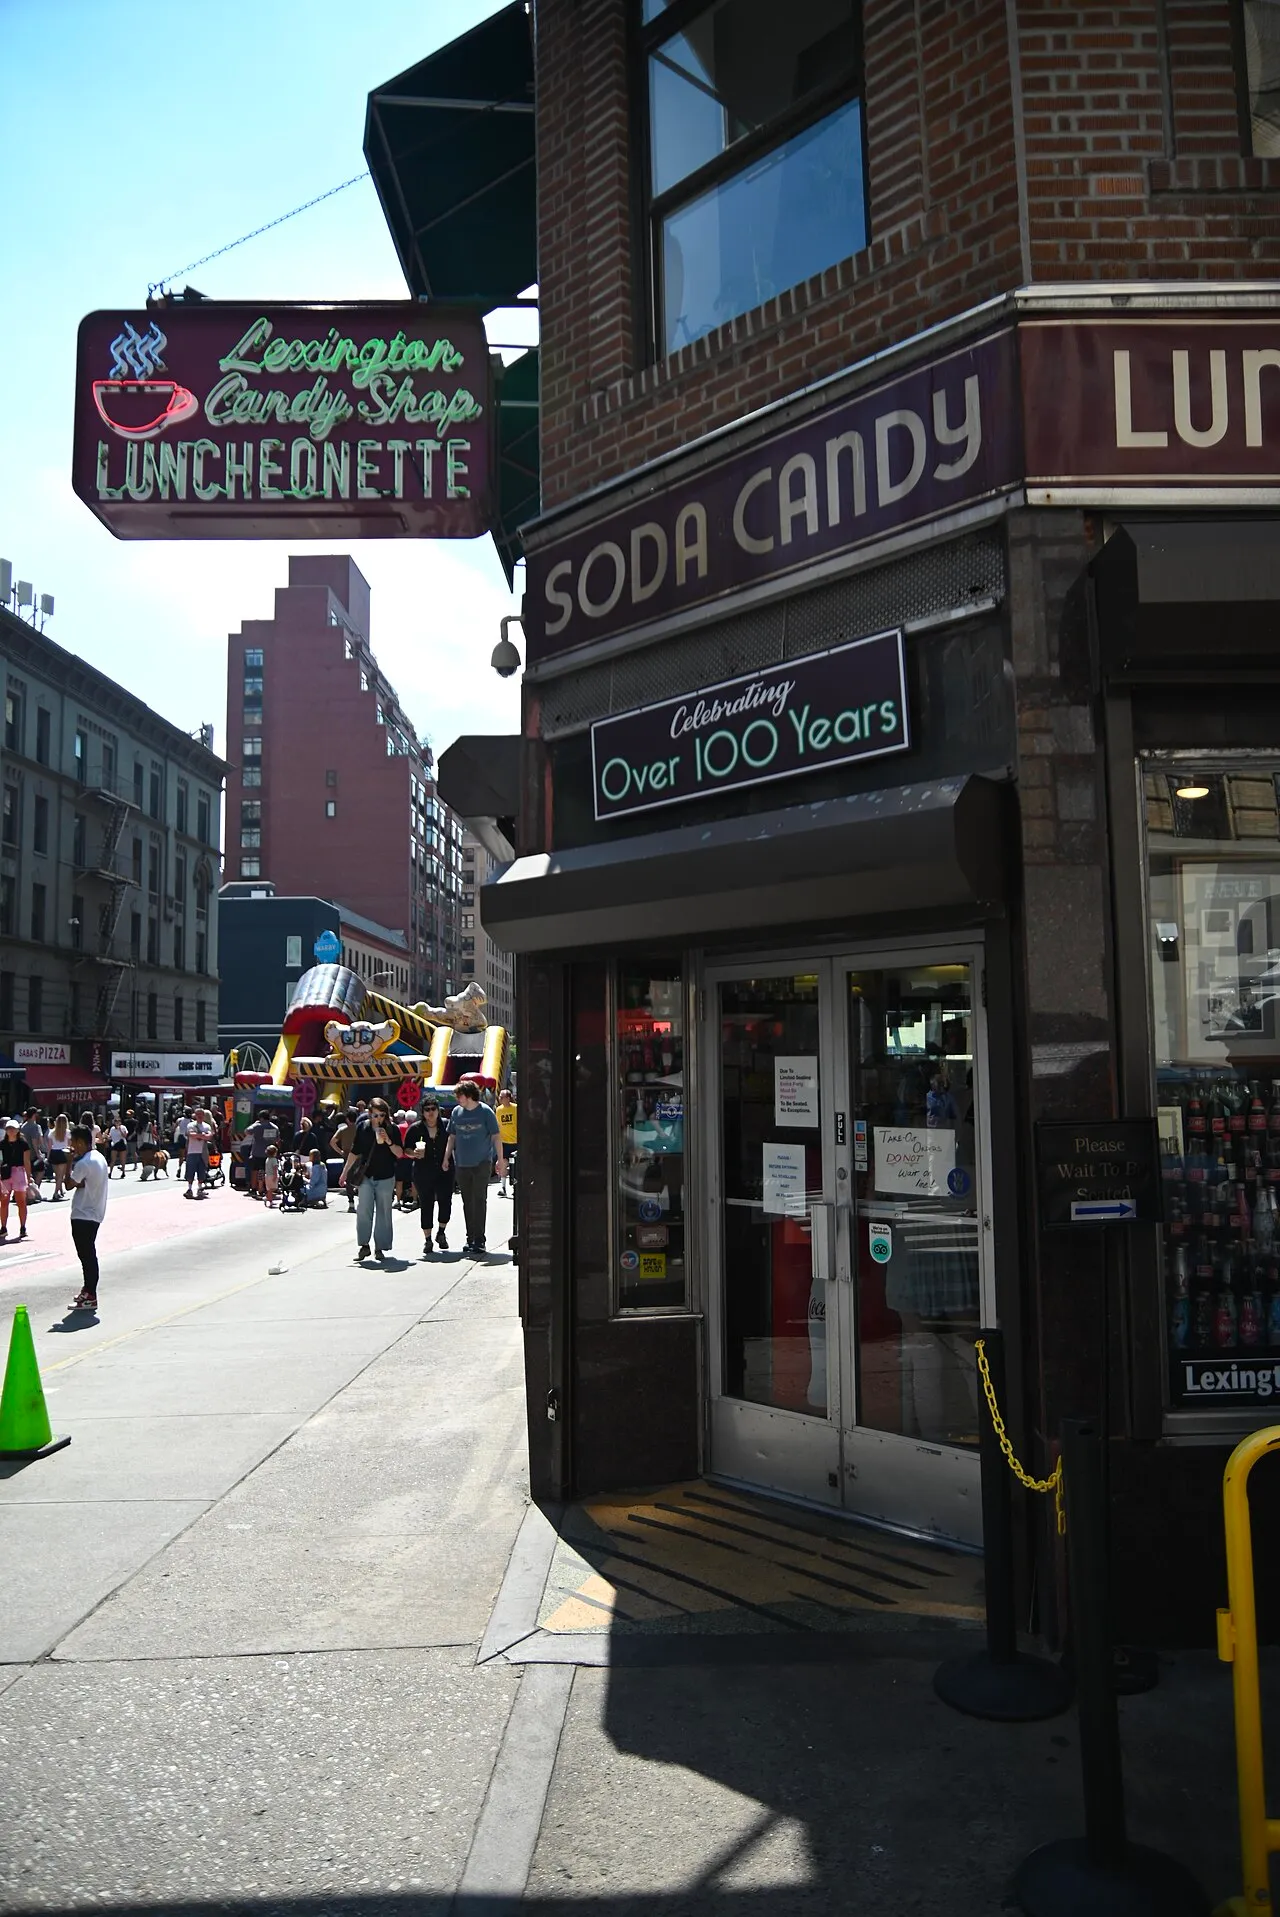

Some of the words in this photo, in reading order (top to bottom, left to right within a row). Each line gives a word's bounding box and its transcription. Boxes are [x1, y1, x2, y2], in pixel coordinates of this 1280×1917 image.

[218, 316, 464, 388] Lexington
[204, 372, 352, 439] Candy
[357, 374, 482, 438] Shop
[96, 438, 471, 500] LUNCHEONETTE
[545, 502, 708, 636] SODA
[732, 374, 981, 556] CANDY
[669, 677, 796, 742] Celebrating
[600, 752, 681, 803] Over
[694, 717, 779, 782] 100
[796, 697, 897, 757] Years
[18, 1048, 38, 1058] SABA'S
[38, 1046, 66, 1060] PIZZA
[92, 1042, 102, 1072] PIZZA
[71, 1091, 93, 1101] PIZZA
[501, 1114, 513, 1123] CAT
[836, 1114, 845, 1143] PULL
[886, 1153, 902, 1163] DO
[902, 1154, 924, 1163] NOT
[1075, 1136, 1126, 1154] Please
[1057, 1163, 1096, 1178] Wait
[1098, 1162, 1120, 1176] To
